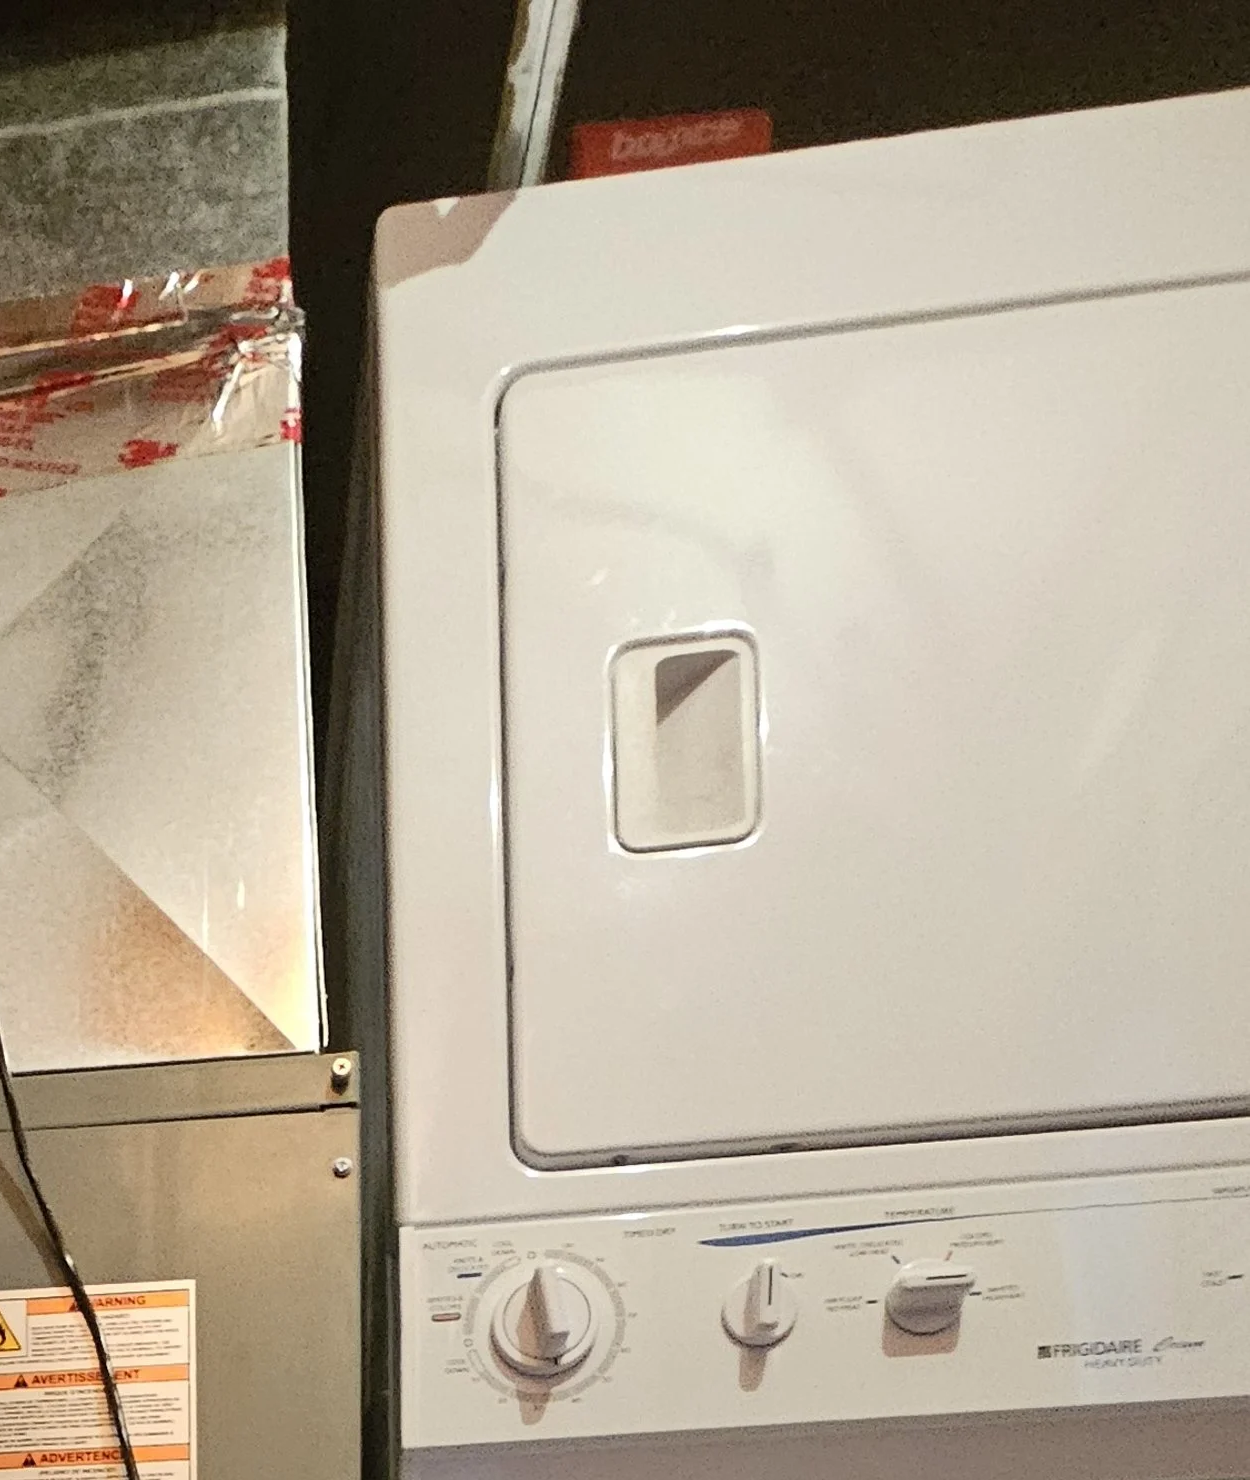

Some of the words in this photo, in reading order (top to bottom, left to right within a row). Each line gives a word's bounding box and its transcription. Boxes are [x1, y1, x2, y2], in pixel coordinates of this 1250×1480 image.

[423, 1239, 477, 1250] AUTOMATIC
[91, 1295, 146, 1307] ARNING
[1053, 1339, 1142, 1357] FRIGIDAIRE
[31, 1369, 140, 1385] AVERTISSEENT
[40, 1449, 122, 1463] ADVERTENC
